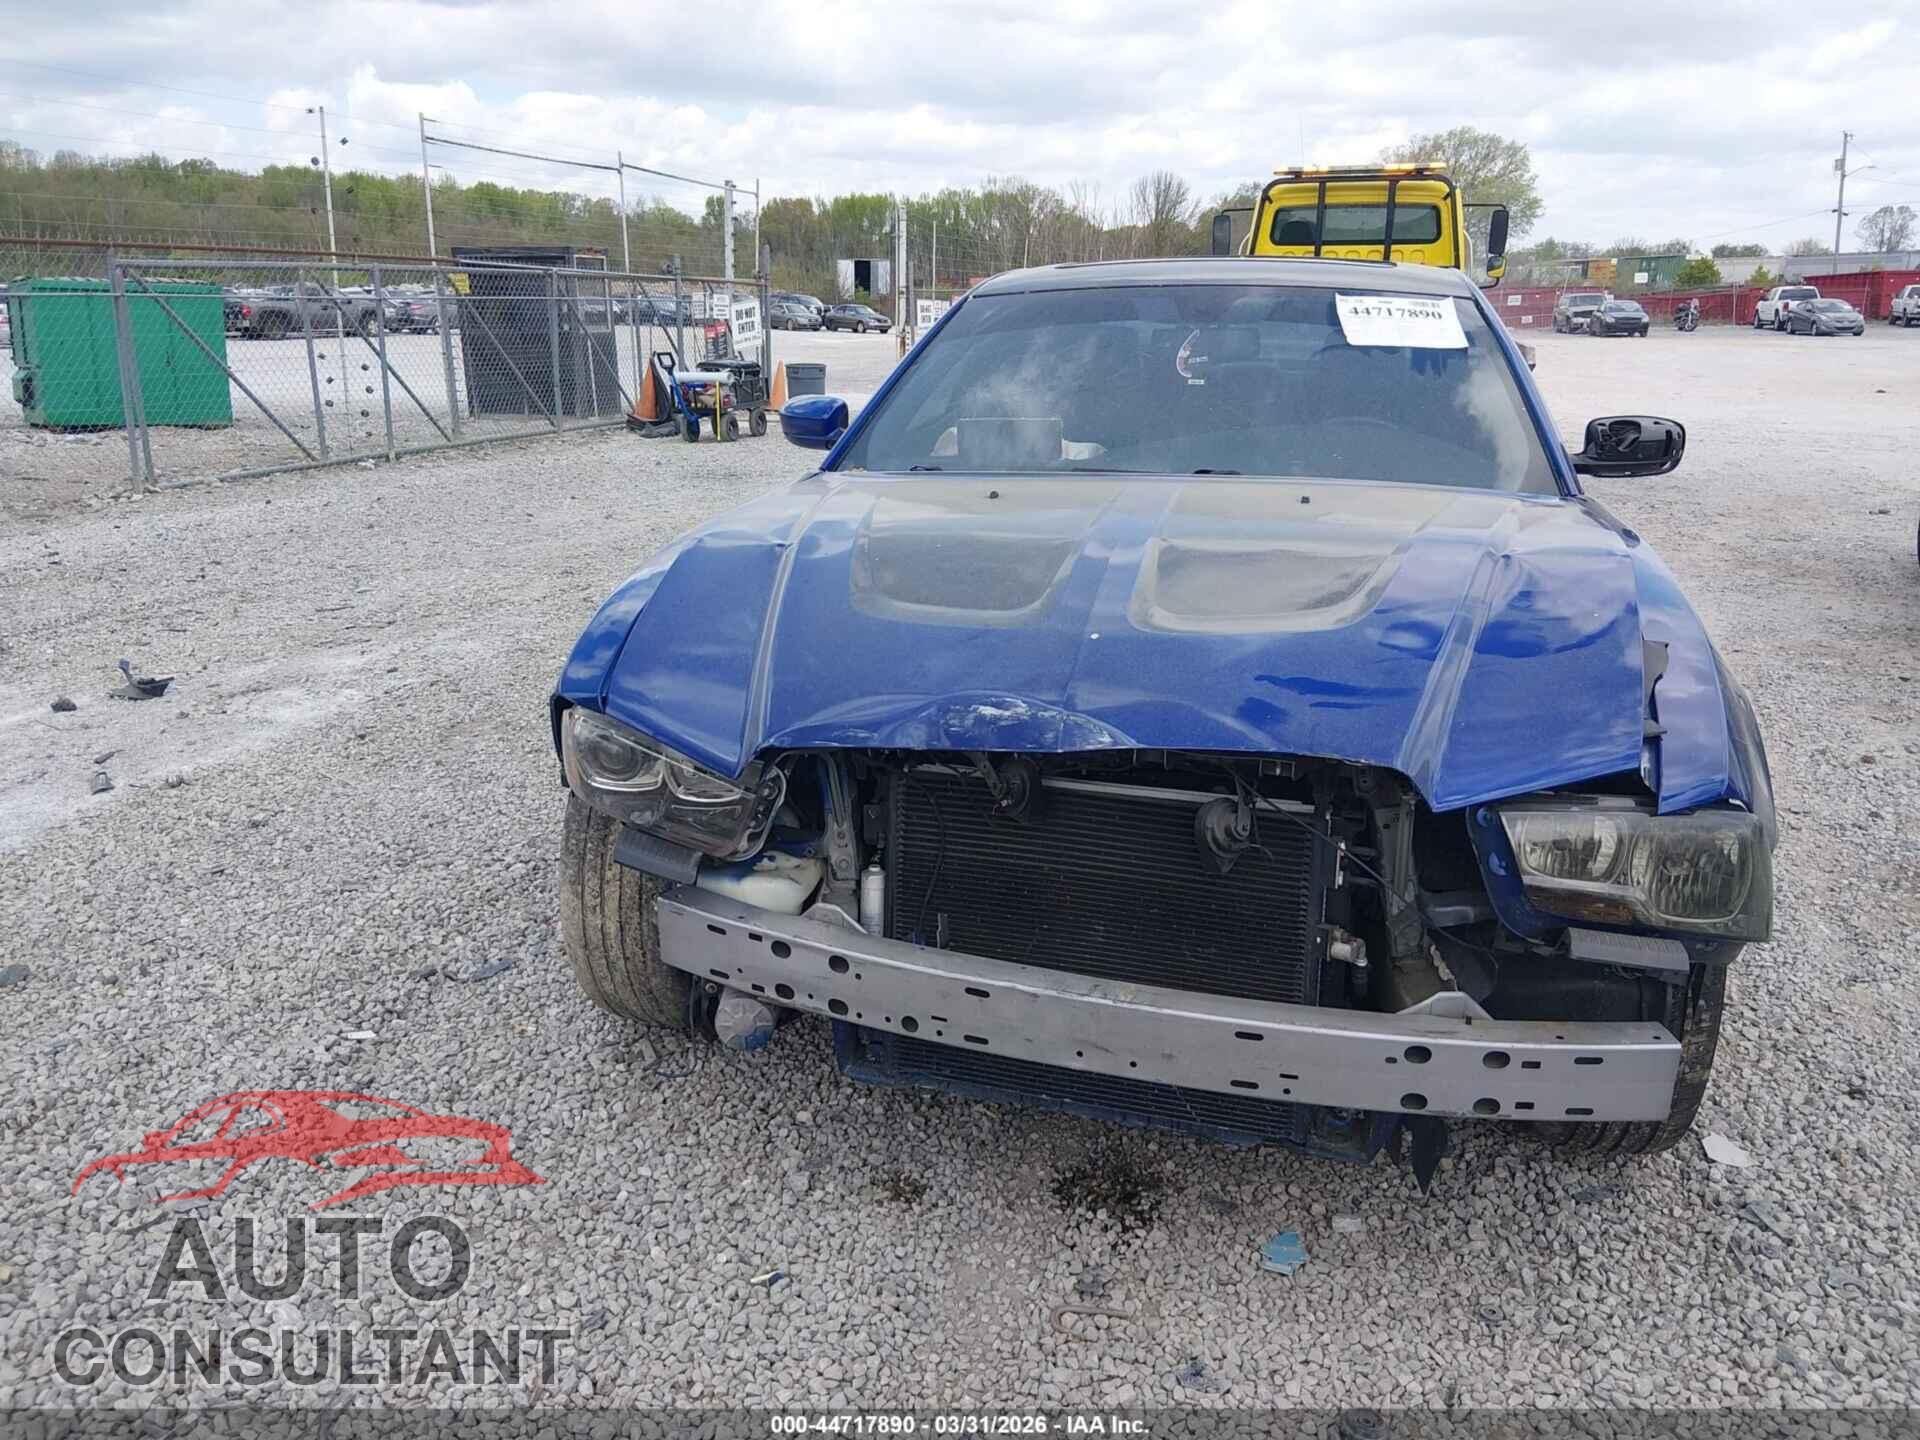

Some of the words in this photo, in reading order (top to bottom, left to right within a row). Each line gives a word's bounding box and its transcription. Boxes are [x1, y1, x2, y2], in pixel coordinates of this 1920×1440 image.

[735, 308, 743, 321] DO
[744, 306, 756, 319] NOT
[1349, 306, 1442, 320] 44717890
[738, 320, 756, 335] ENTER
